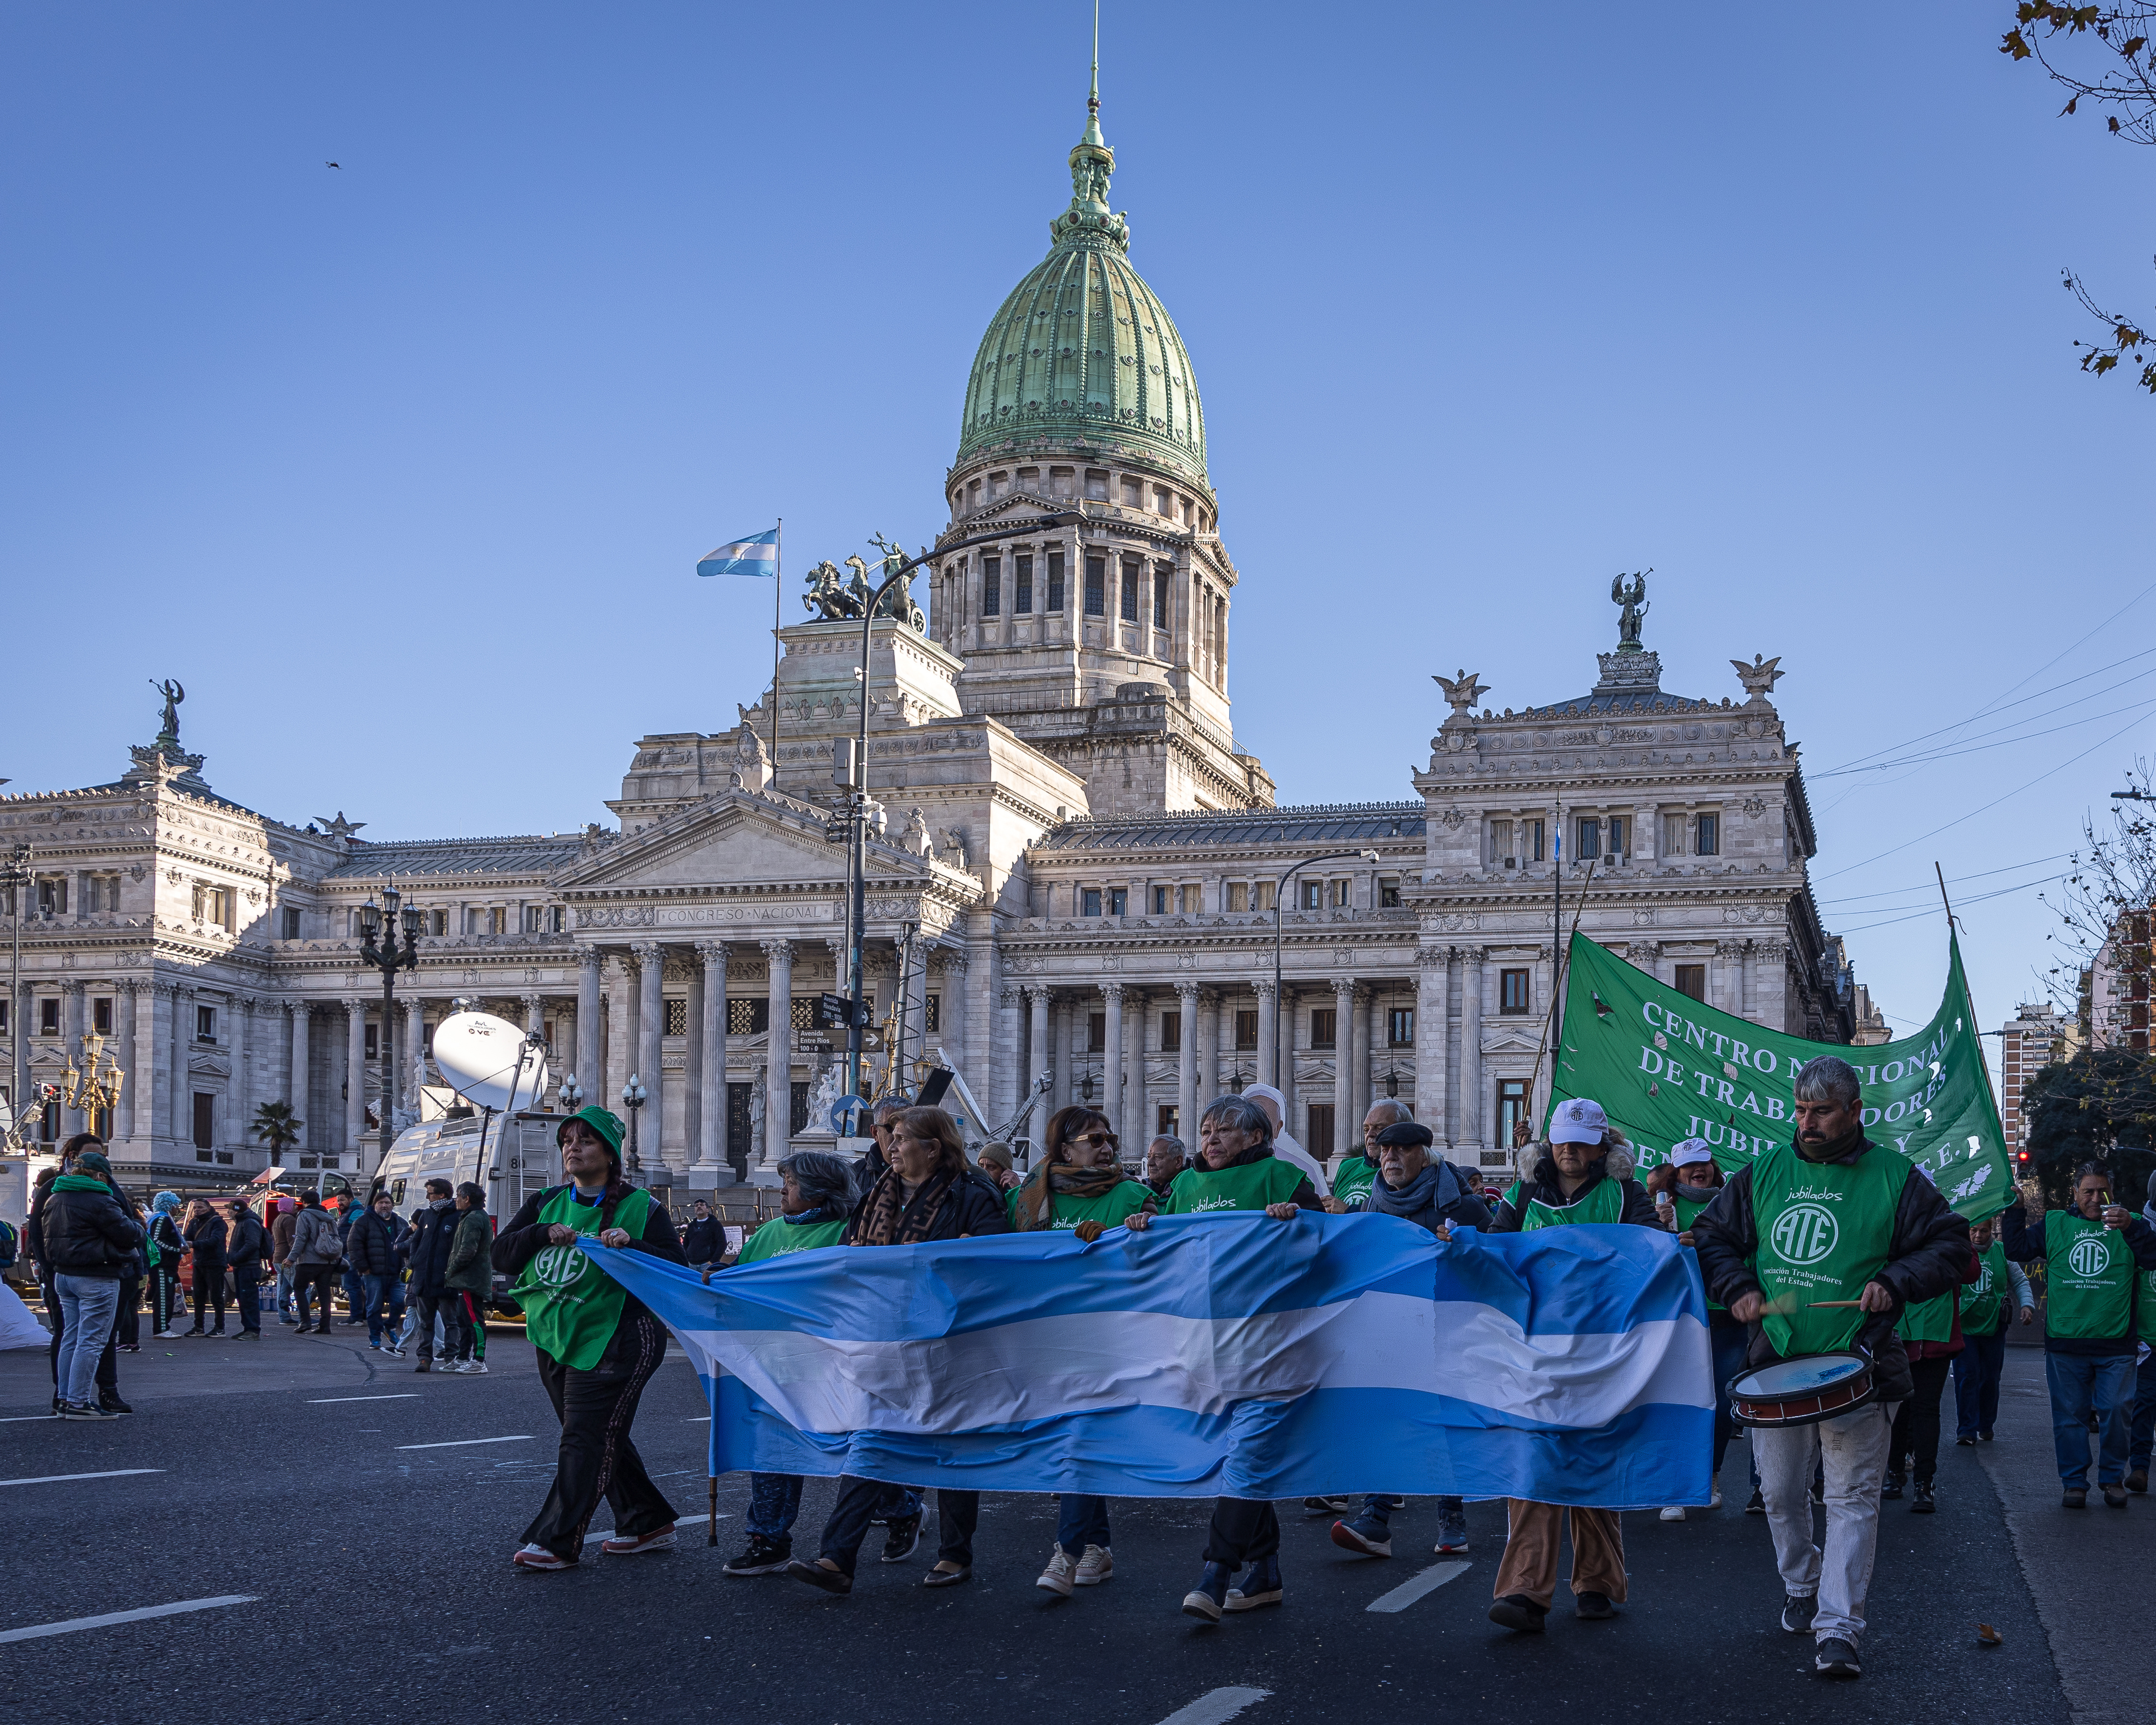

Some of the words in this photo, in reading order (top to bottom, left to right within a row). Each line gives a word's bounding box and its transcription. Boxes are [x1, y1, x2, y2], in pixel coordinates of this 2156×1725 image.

[668, 909, 743, 921] CONGRESO
[753, 907, 821, 919] NACIONAL
[823, 1002, 841, 1013] Rivadavia
[824, 995, 838, 1004] Avenida
[1643, 1002, 1777, 1073] CENTRO
[1638, 1045, 1684, 1086] DE
[1893, 1131, 1913, 1153] Y
[511, 1158, 525, 1169] 80
[1785, 1185, 1843, 1202] jubilados
[1776, 1208, 1831, 1258] ATE
[2073, 1228, 2108, 1241] jubilados
[539, 1245, 583, 1282] ATE
[2072, 1242, 2104, 1273] ATE
[1788, 1277, 1814, 1288] Estado
[1792, 1268, 1843, 1285] Trabajadores
